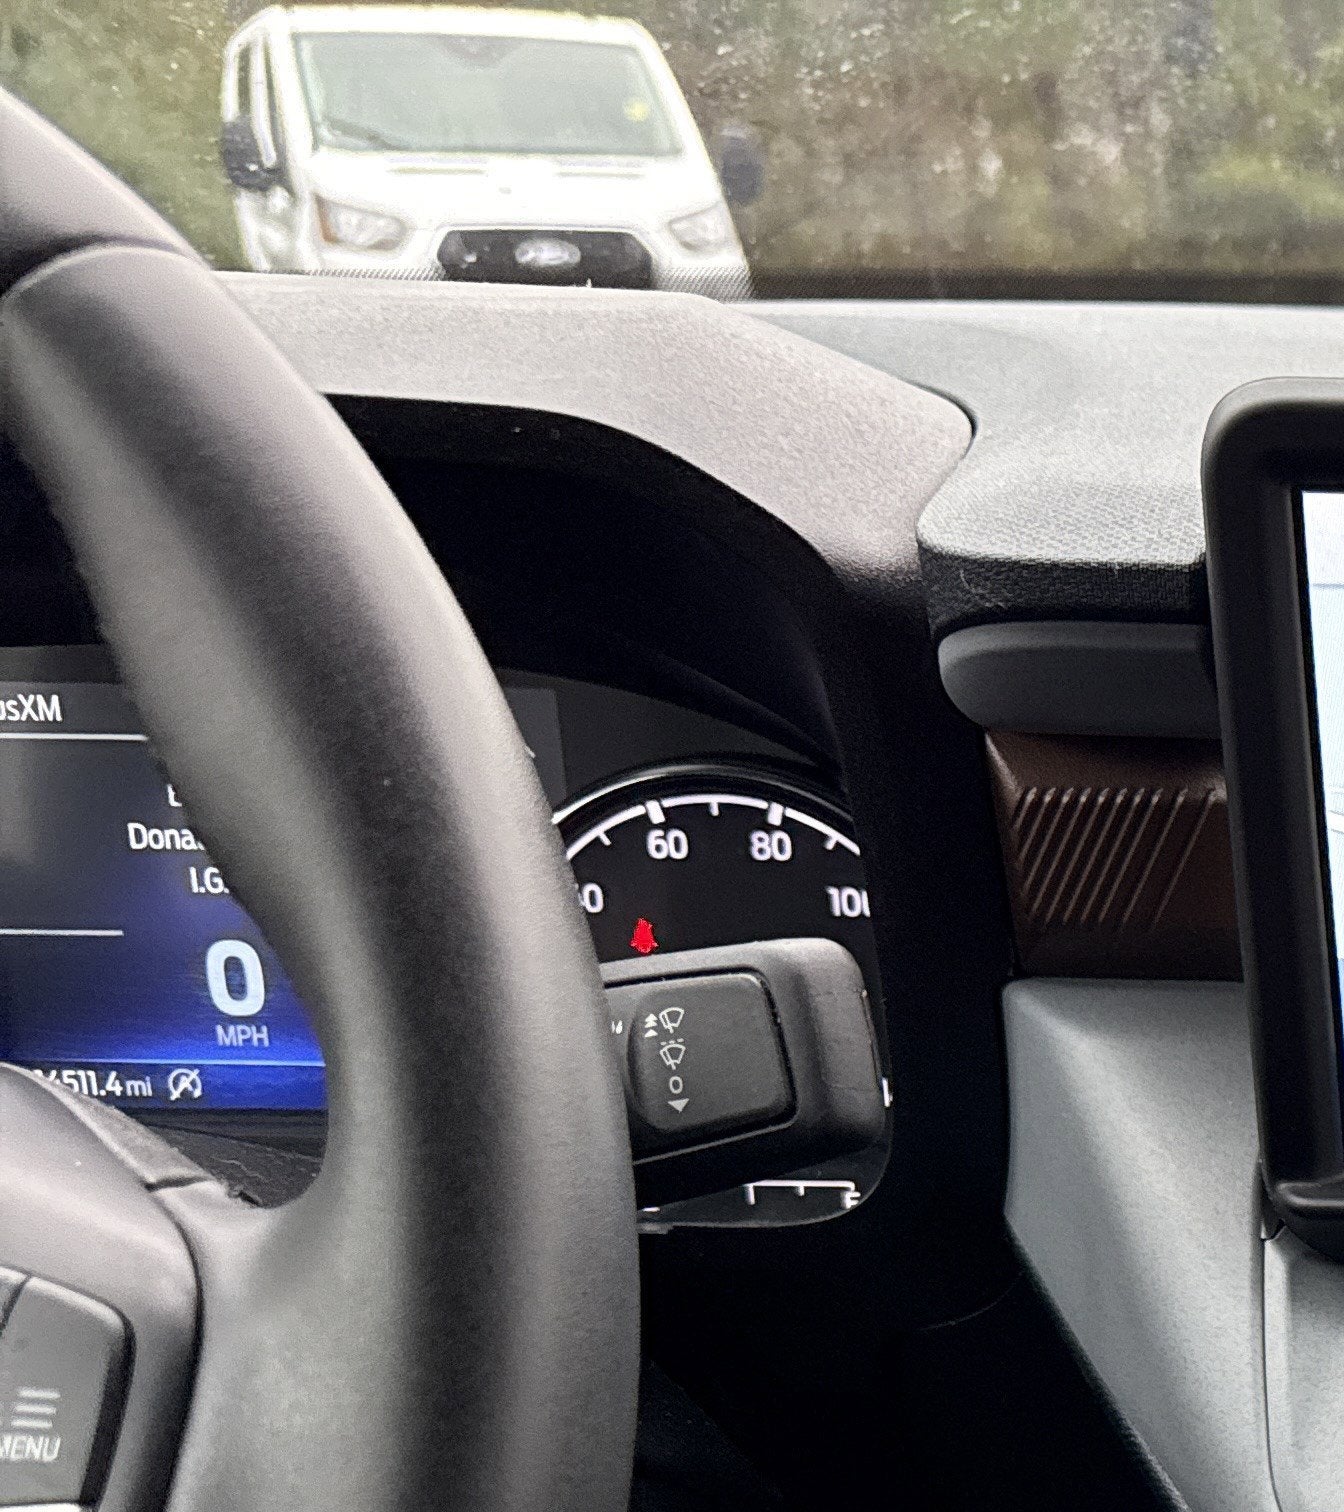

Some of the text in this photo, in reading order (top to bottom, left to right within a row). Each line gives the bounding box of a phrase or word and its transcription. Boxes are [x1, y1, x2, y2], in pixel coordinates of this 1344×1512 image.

[127, 823, 206, 852] Dona
[645, 828, 689, 860] 60
[749, 828, 793, 862] 80
[204, 938, 266, 1018] 0
[215, 1024, 270, 1049] MPH
[125, 1076, 153, 1097] mi
